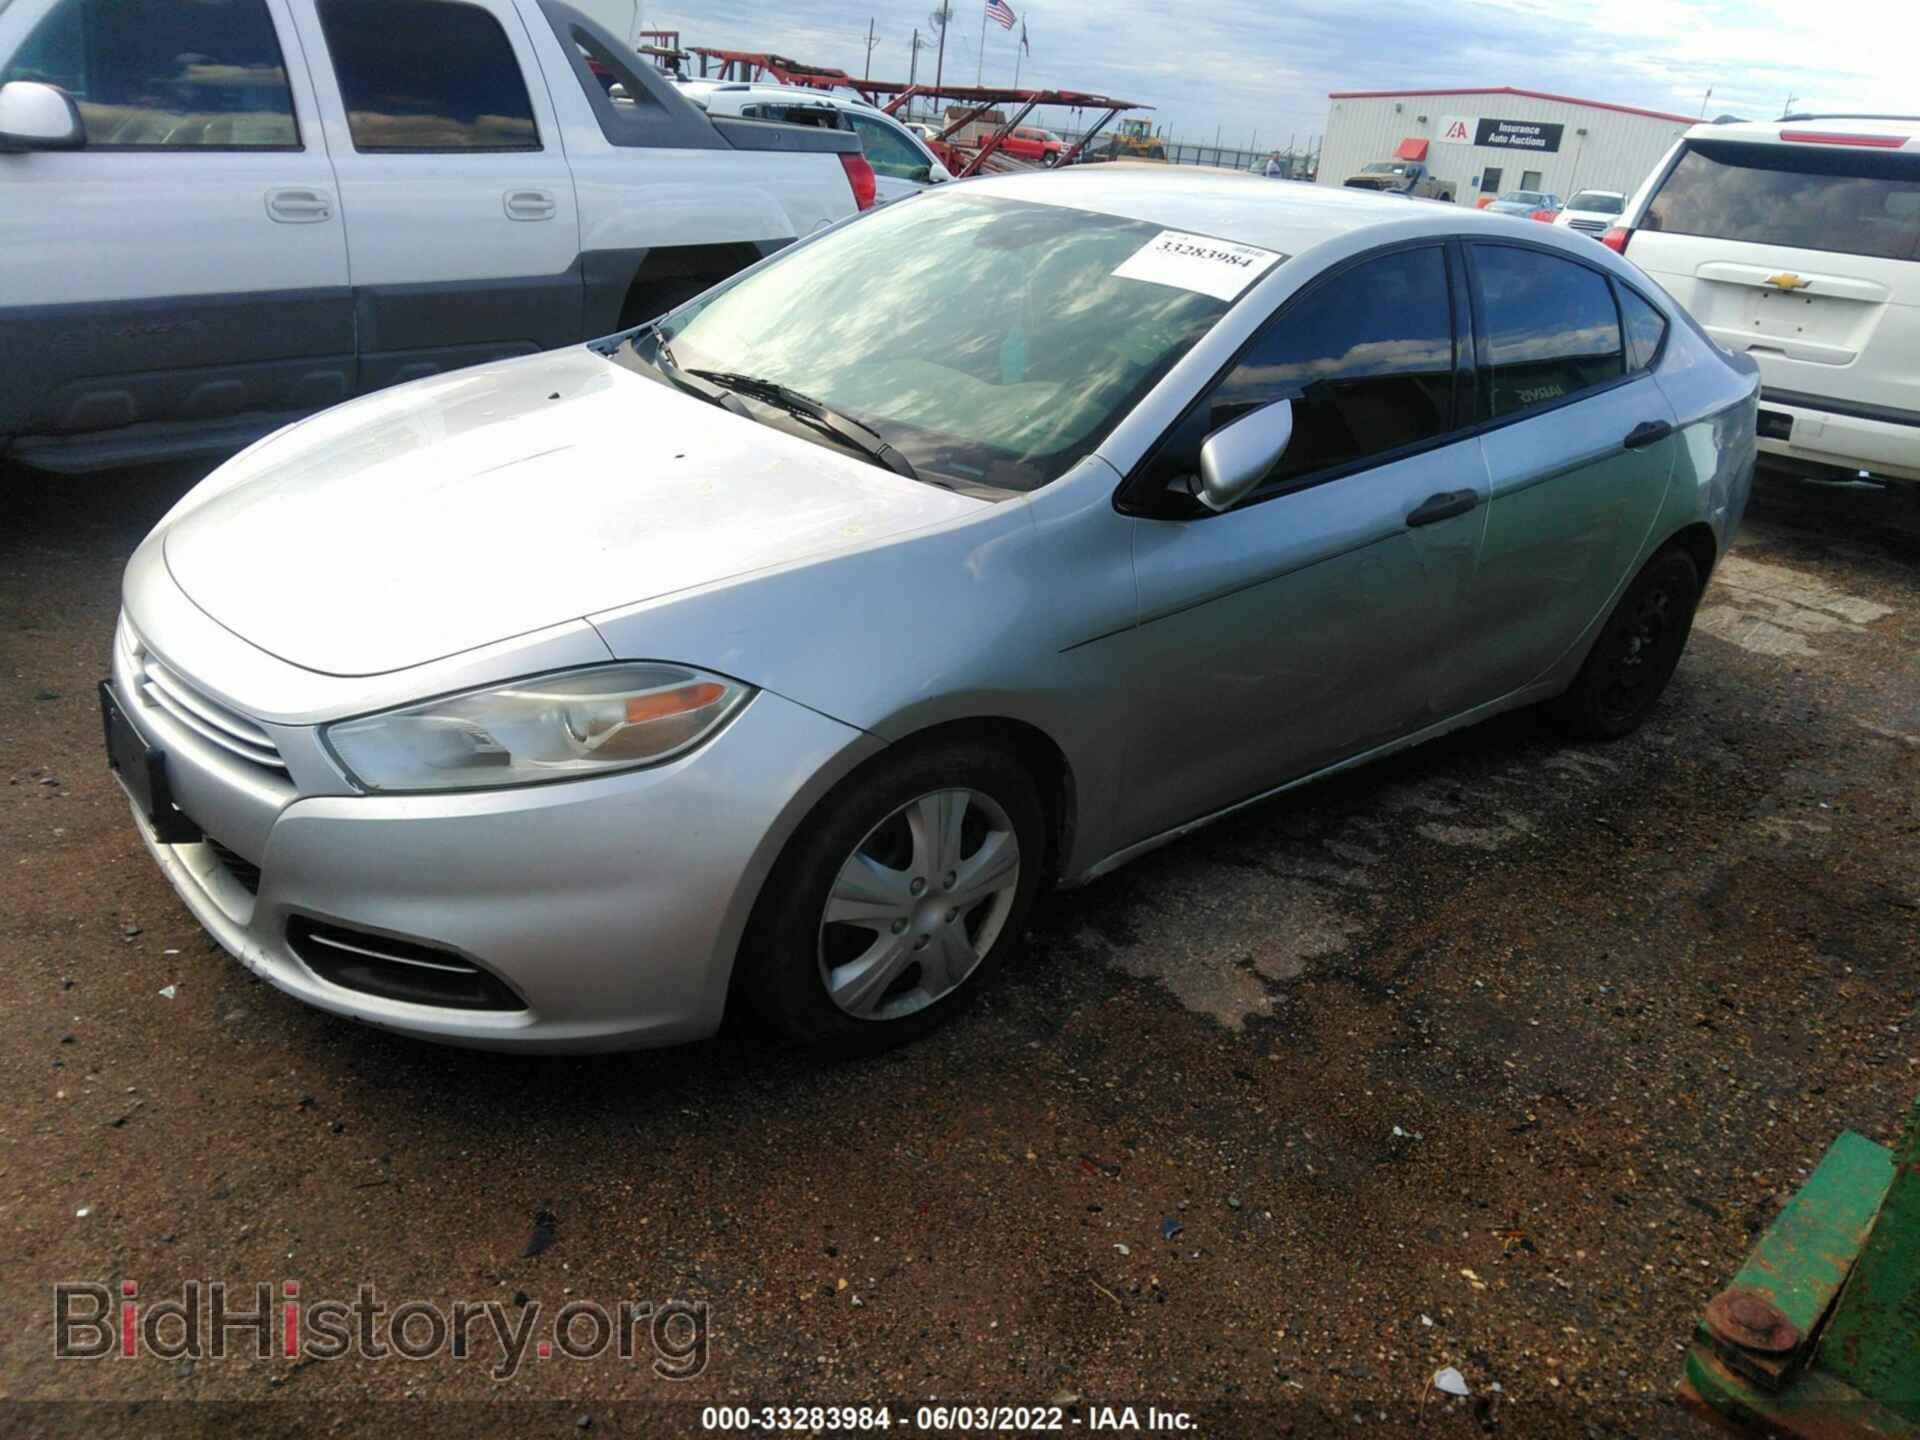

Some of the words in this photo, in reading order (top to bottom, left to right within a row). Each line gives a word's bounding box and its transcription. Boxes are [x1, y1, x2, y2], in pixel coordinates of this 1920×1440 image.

[1498, 122, 1540, 135] Insurance
[1488, 132, 1508, 144] Auto
[1509, 134, 1546, 147] Auctions
[1156, 241, 1254, 268] 33283984
